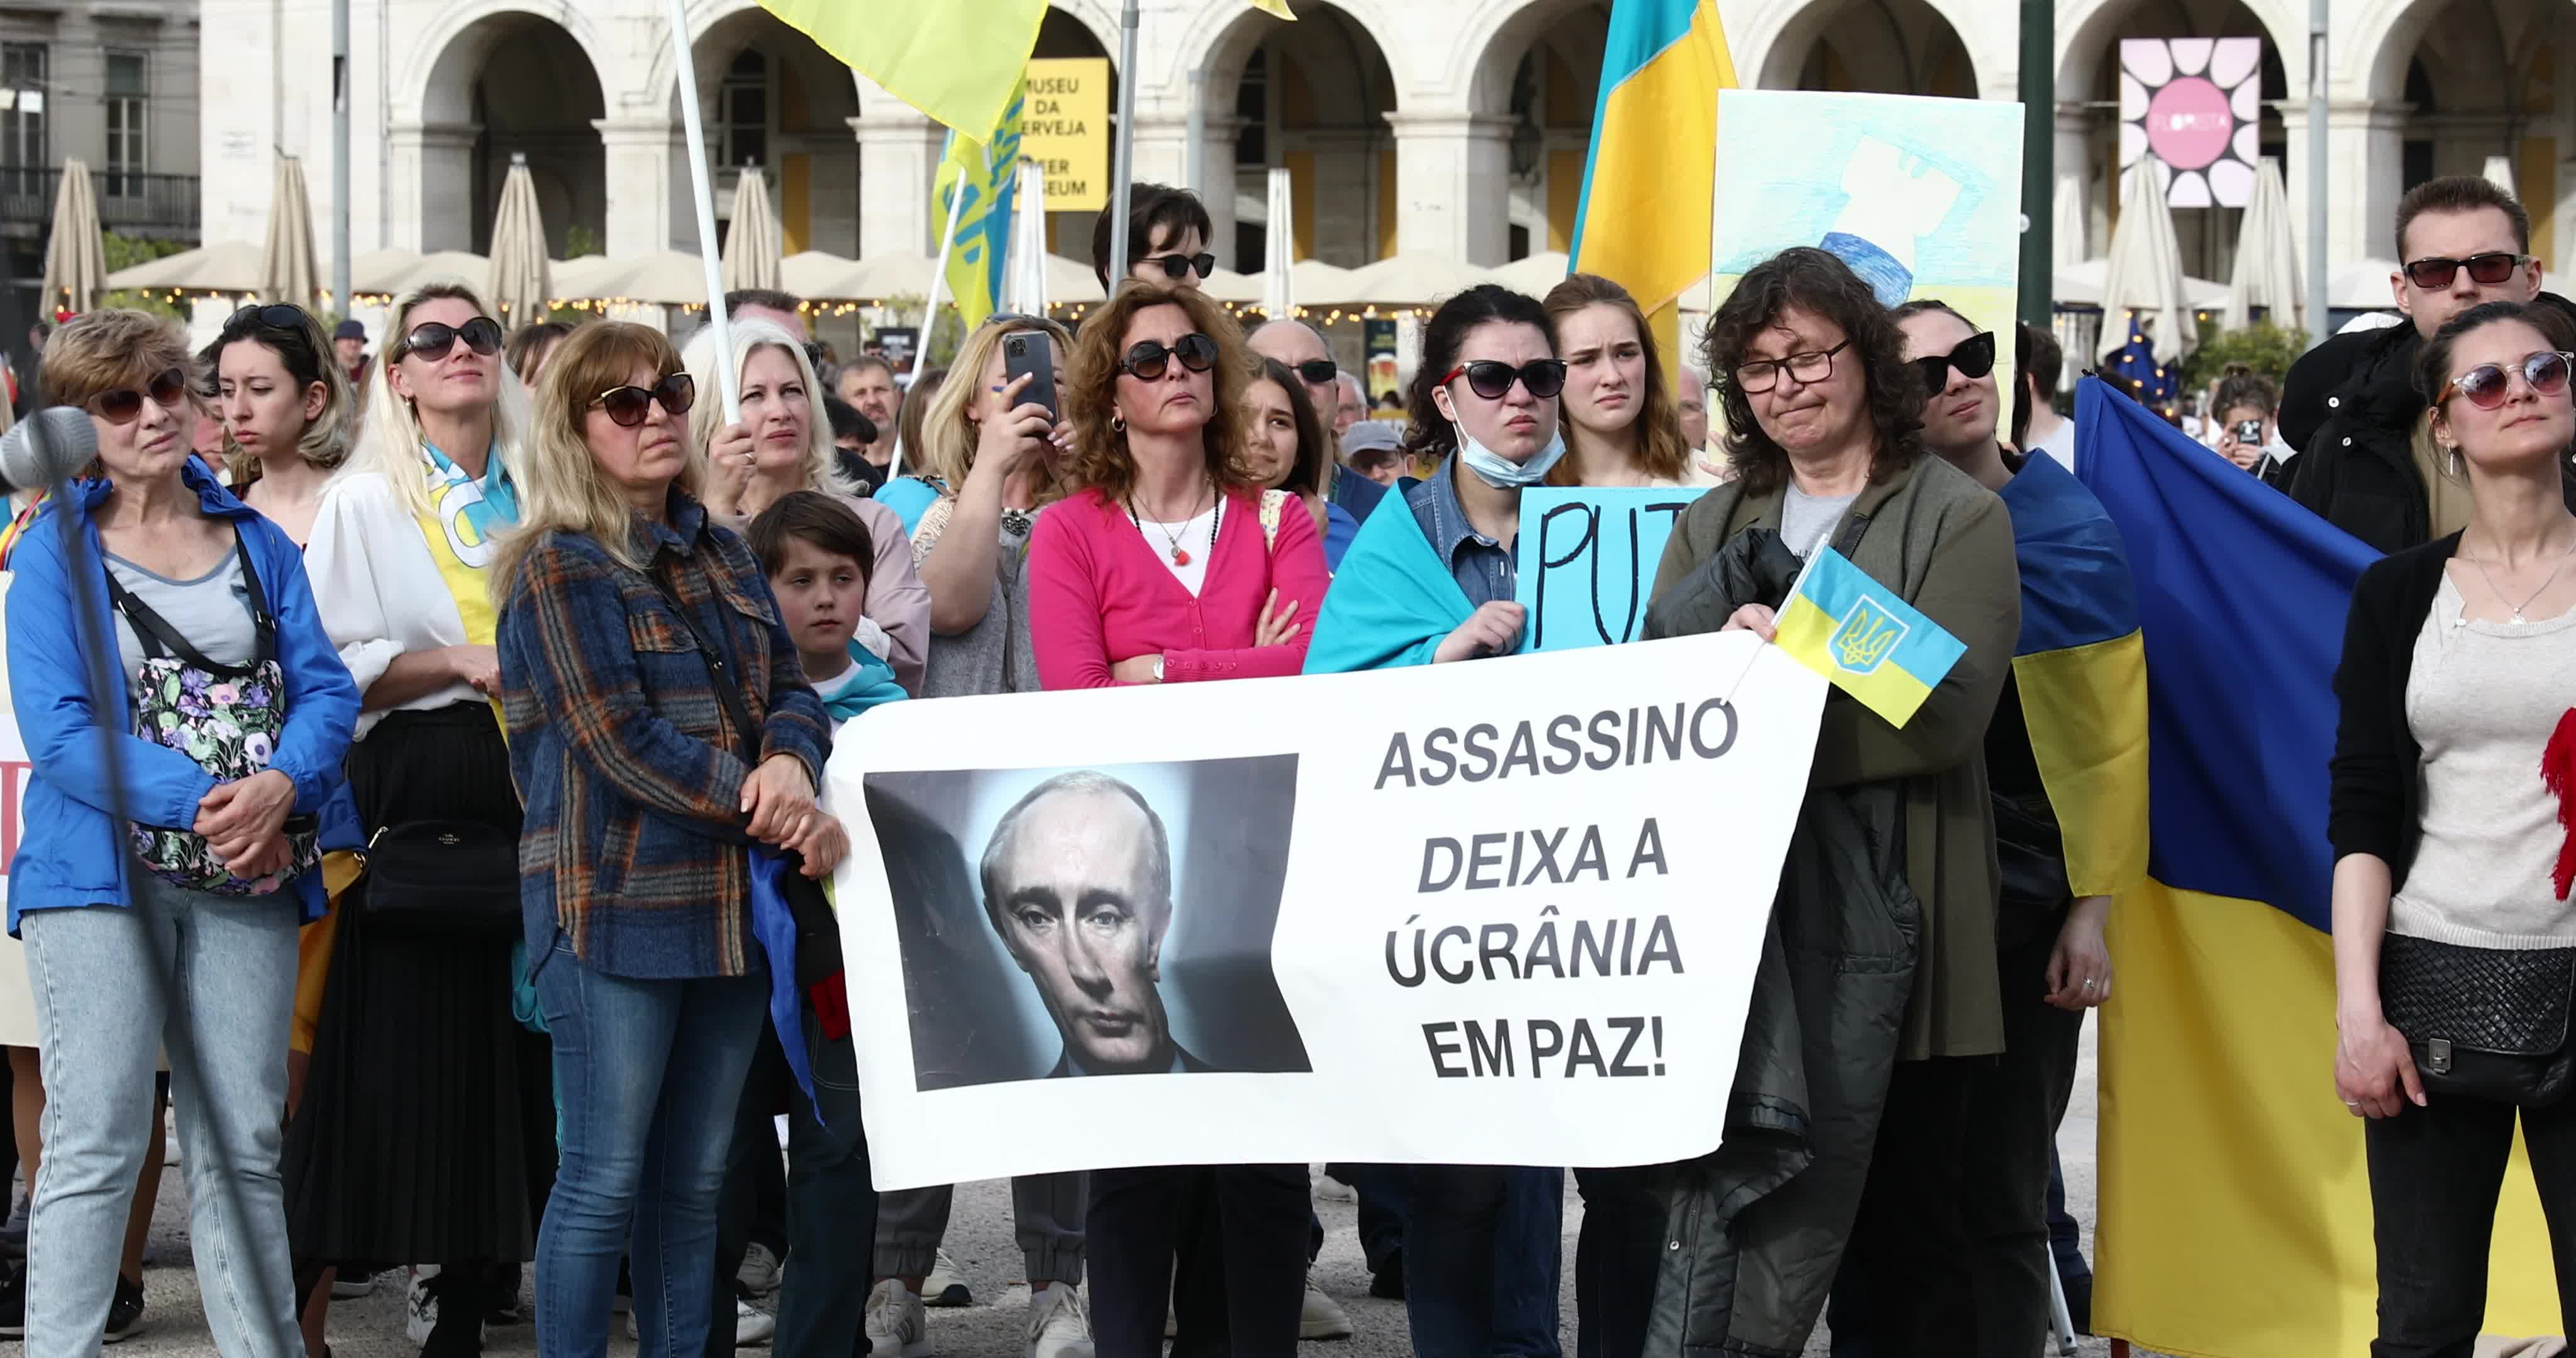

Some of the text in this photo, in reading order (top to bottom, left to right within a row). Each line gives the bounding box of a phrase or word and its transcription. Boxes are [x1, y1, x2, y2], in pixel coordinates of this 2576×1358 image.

[1021, 121, 1086, 135] ERVEJA
[1035, 100, 1060, 114] DA
[1036, 158, 1070, 174] ER
[1374, 698, 1738, 790] ASSASSINO
[1418, 817, 1668, 893] DEIXA A
[1385, 905, 1684, 988] ÚCRÂNIA
[1421, 1015, 1666, 1079] EM PAZ!
